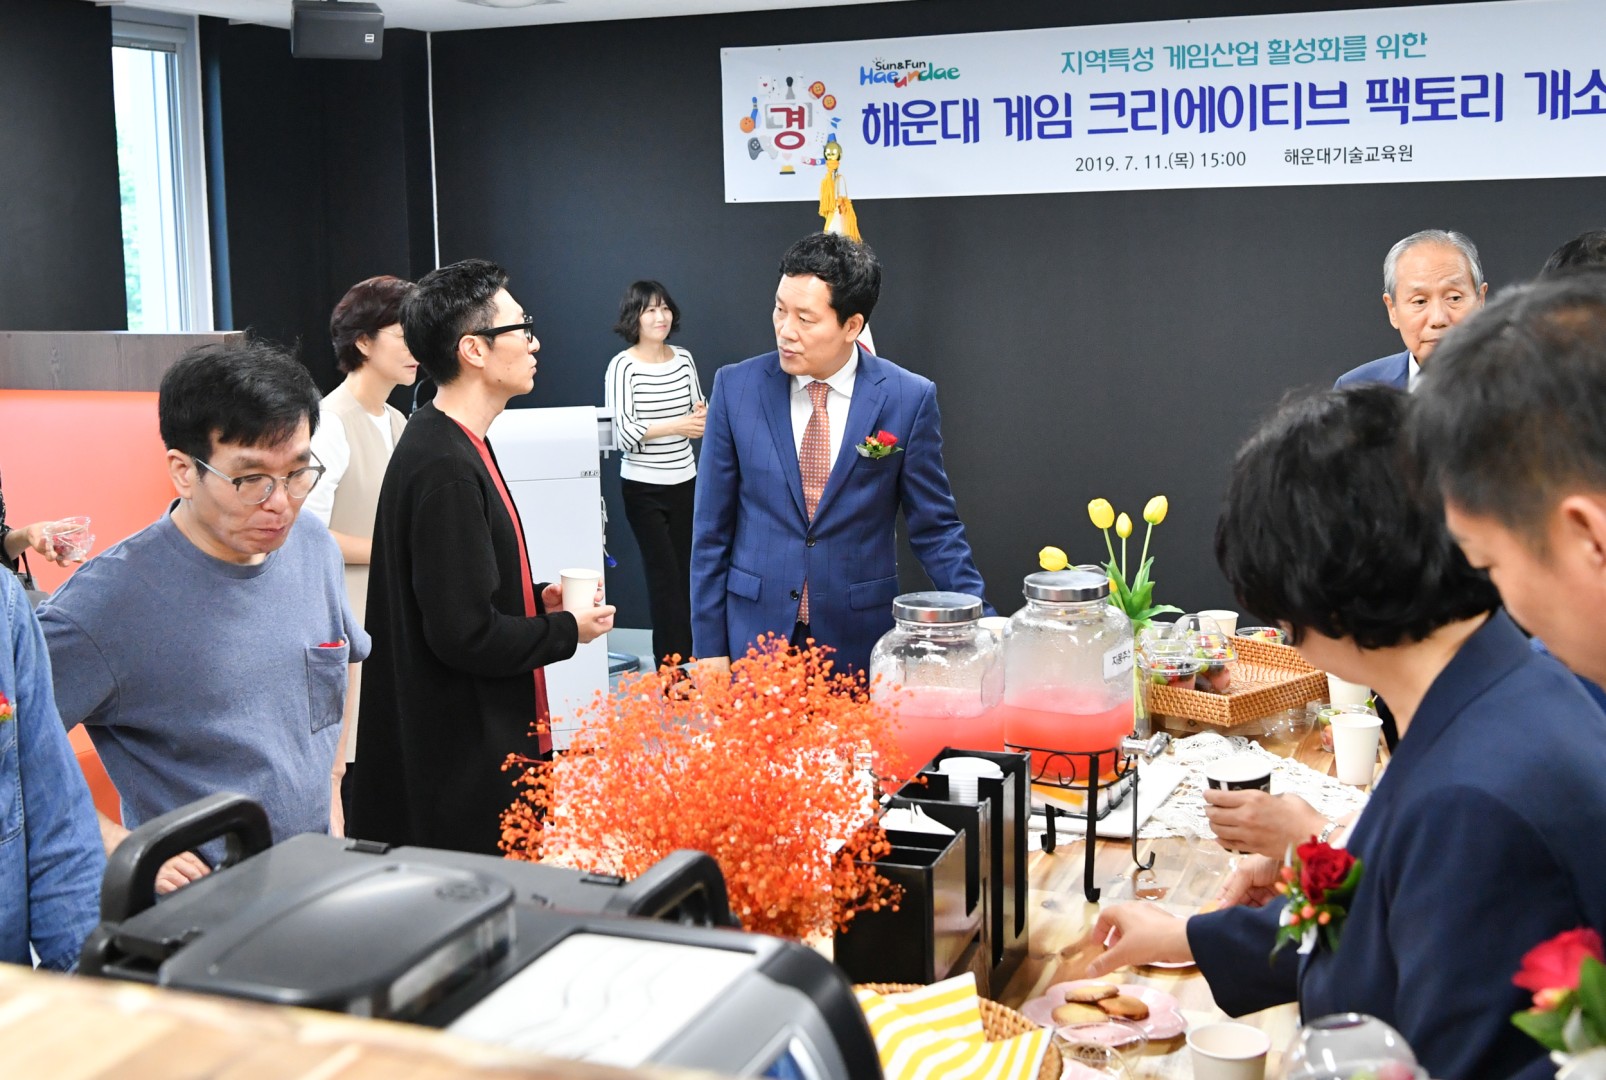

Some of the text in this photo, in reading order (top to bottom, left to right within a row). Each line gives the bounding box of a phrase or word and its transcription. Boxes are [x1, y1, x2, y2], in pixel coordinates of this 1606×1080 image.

[875, 59, 927, 71] Sun&Fun
[1060, 31, 1428, 76] 지역특성 게임산업 활성화를 위한
[770, 105, 806, 150] 경
[862, 68, 1606, 147] 해운대 게임 크리에이티브 팩토리 개소
[1075, 156, 1119, 172] 2019.
[1125, 155, 1138, 171] 7.
[1201, 151, 1246, 168] 15:00
[1284, 144, 1413, 166] 해운대기술교육원
